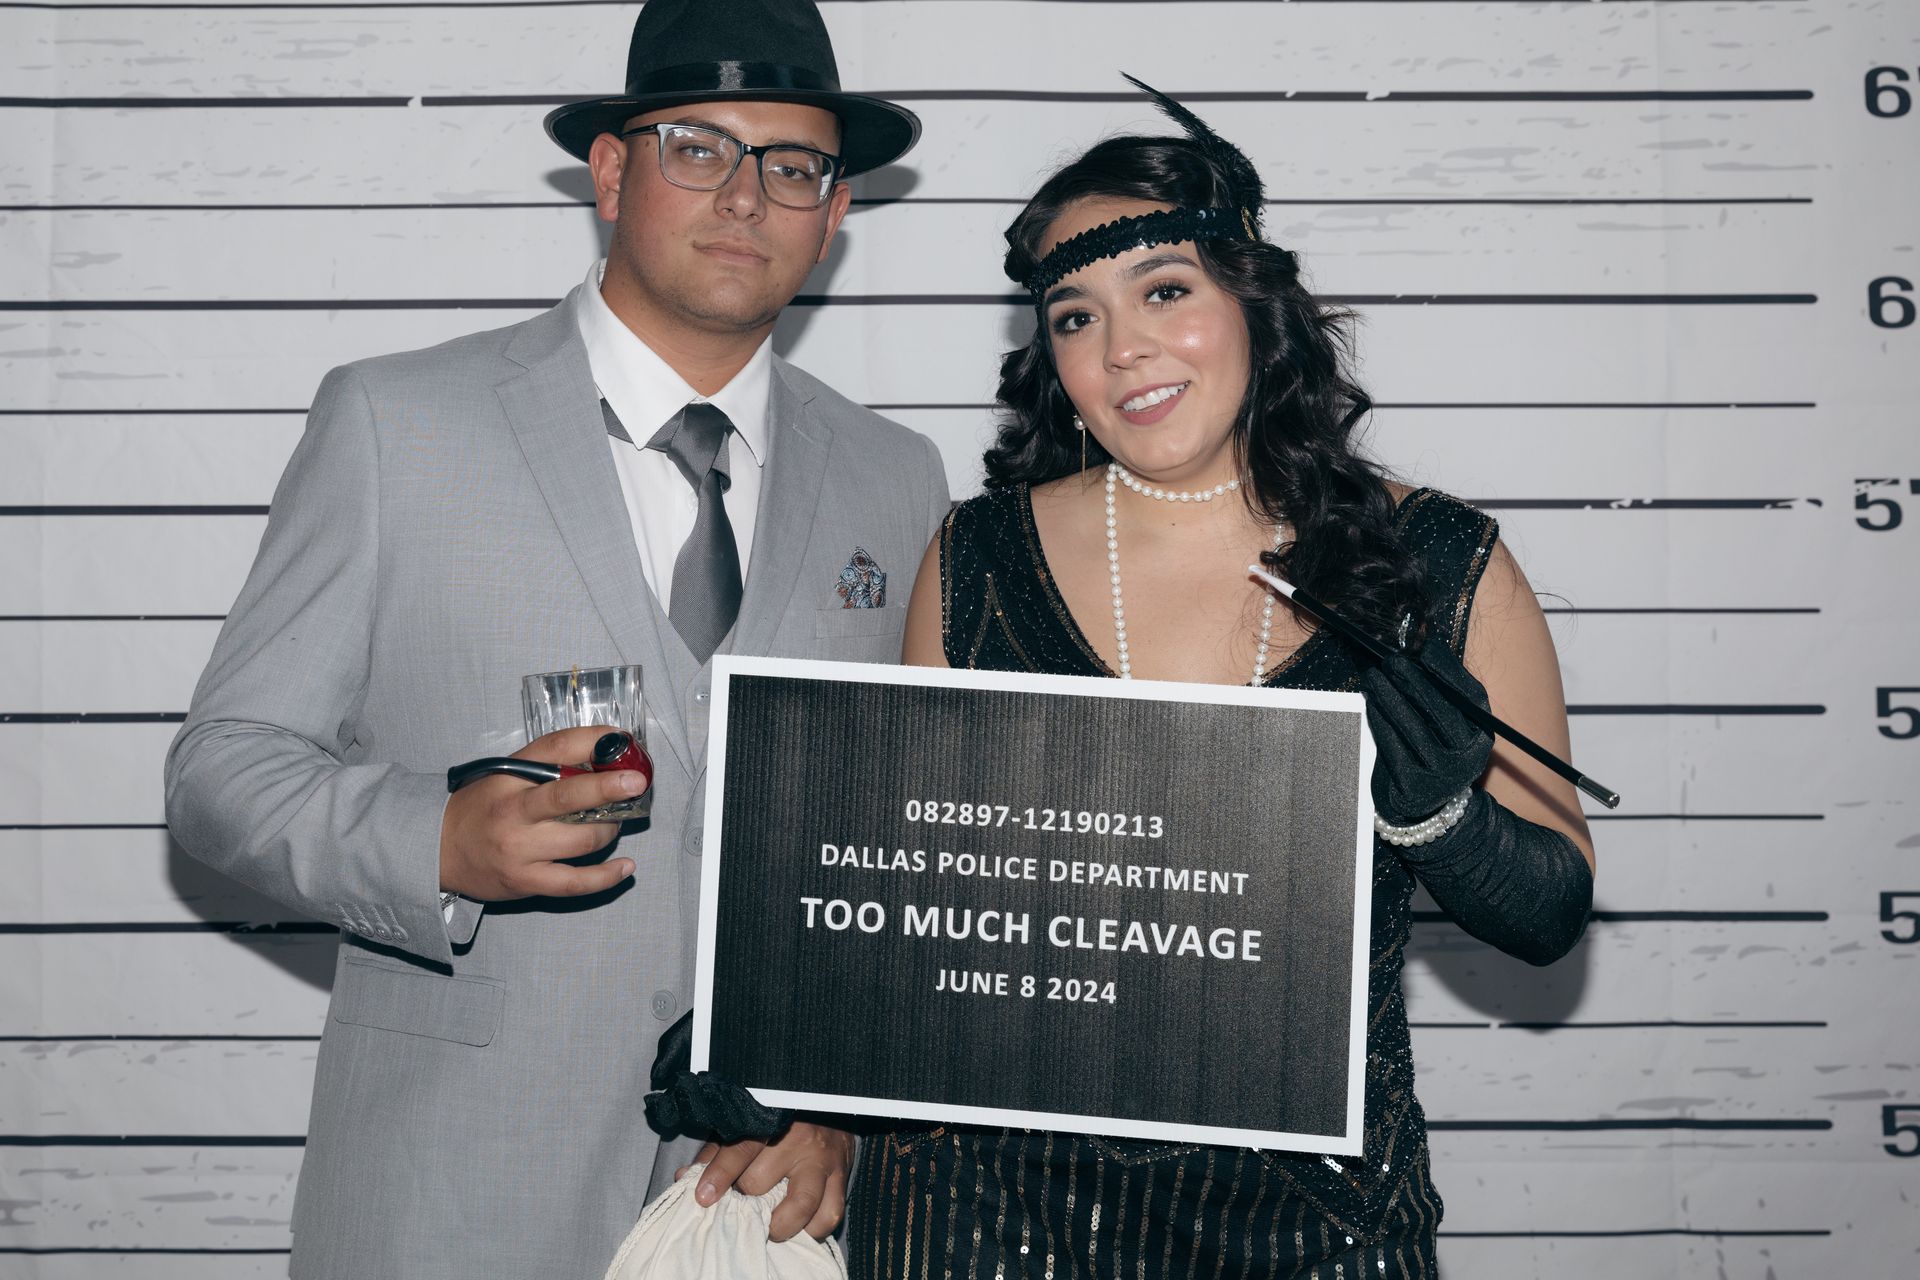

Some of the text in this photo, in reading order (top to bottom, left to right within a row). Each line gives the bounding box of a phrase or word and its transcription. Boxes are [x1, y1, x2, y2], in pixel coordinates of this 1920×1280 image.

[1864, 66, 1920, 118] 6
[1868, 276, 1916, 329] 6
[1876, 686, 1920, 740] 5
[905, 799, 1164, 839] 082897-12190213
[821, 843, 1250, 896] DALLAS POLICE DEPARTMENT
[800, 896, 1262, 962] TOO MUCH CLEAVAGE
[935, 969, 1117, 1004] JUNE 8 2024
